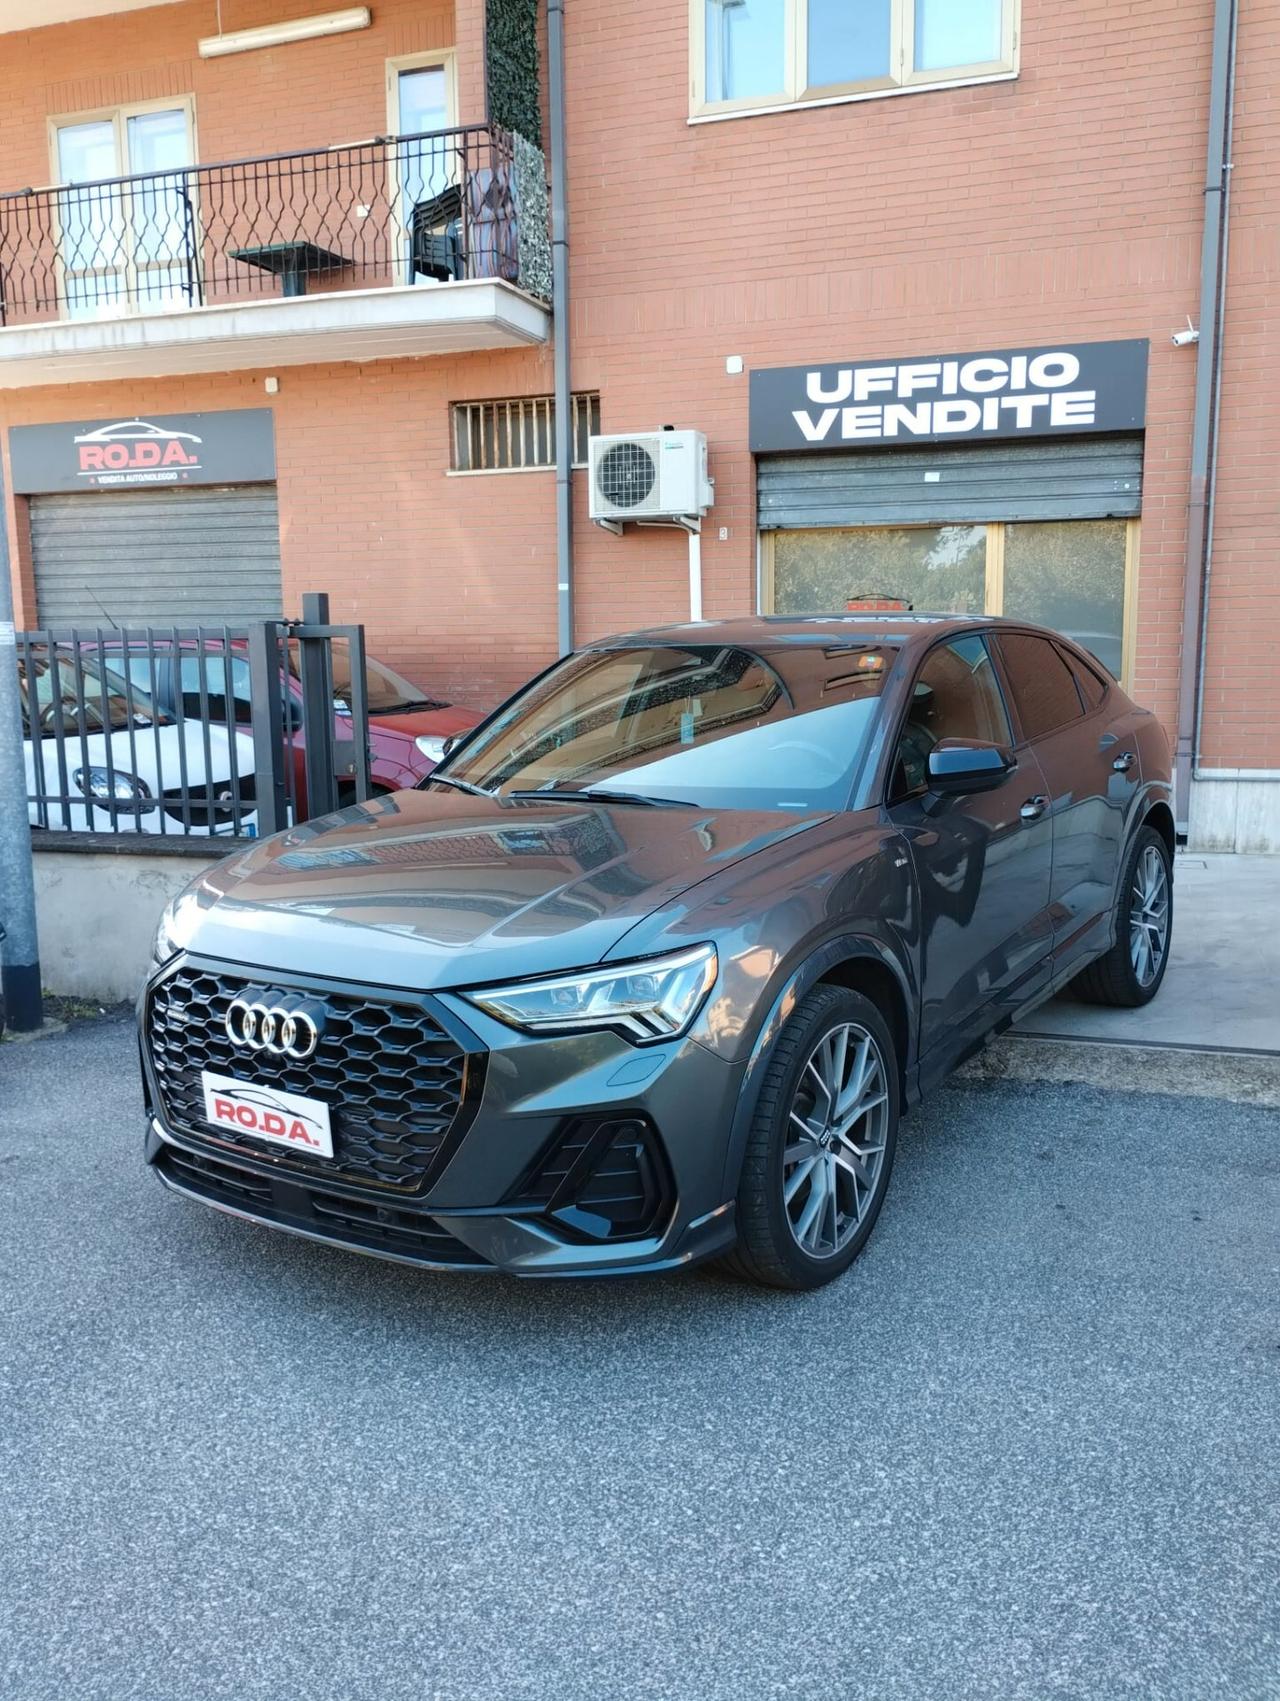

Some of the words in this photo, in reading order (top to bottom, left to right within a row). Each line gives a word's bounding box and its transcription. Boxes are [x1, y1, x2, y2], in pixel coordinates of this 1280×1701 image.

[806, 352, 1080, 403] UFFICIO
[792, 390, 1096, 441] VENDITE
[79, 440, 198, 470] RO.DA.
[97, 475, 125, 484] VENDITA
[215, 1099, 320, 1146] RO.DA.
